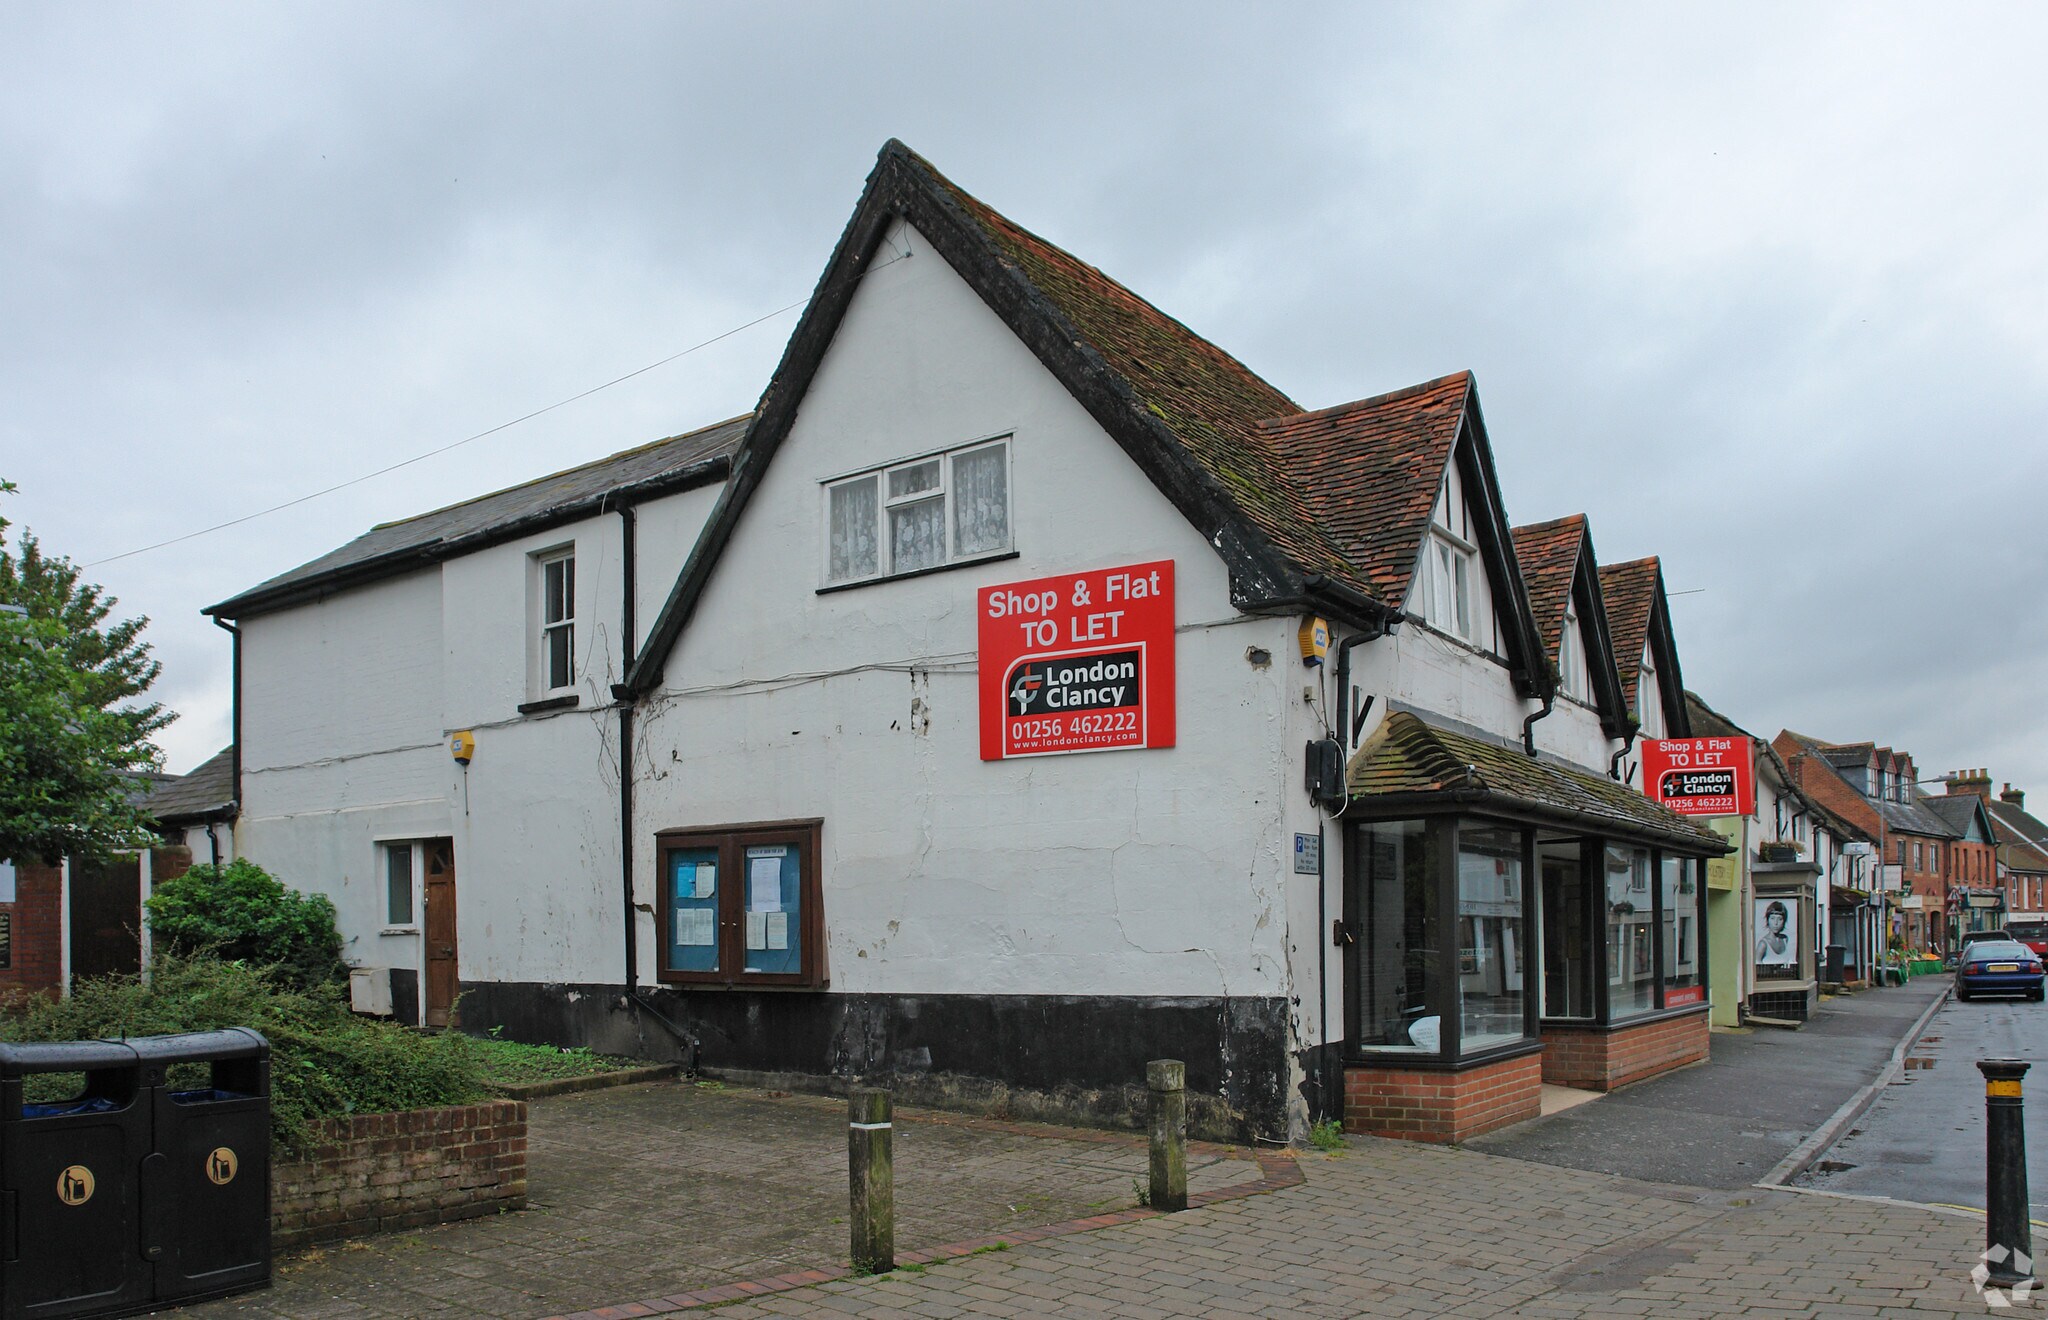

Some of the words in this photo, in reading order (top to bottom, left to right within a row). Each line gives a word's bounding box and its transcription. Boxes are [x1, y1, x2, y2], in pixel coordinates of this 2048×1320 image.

[988, 590, 1058, 618] Shop
[1071, 579, 1092, 607] &
[1106, 570, 1160, 602] Flat
[1020, 619, 1058, 648] TO
[1071, 611, 1124, 642] LET
[1046, 660, 1135, 686] London
[1046, 686, 1126, 707] Clancy
[1012, 719, 1062, 740] 01256
[1069, 712, 1136, 735] 462222
[1013, 732, 1138, 749] www.londonclancy.com
[1659, 741, 1690, 753] Shop
[1695, 740, 1704, 751] &
[1709, 740, 1731, 750] Flat
[1668, 753, 1689, 766] TO
[1695, 752, 1723, 765] LET
[1683, 773, 1731, 784] London
[1683, 784, 1727, 795] Clancy
[1664, 799, 1693, 808] 01256
[1697, 797, 1733, 807] 462222
